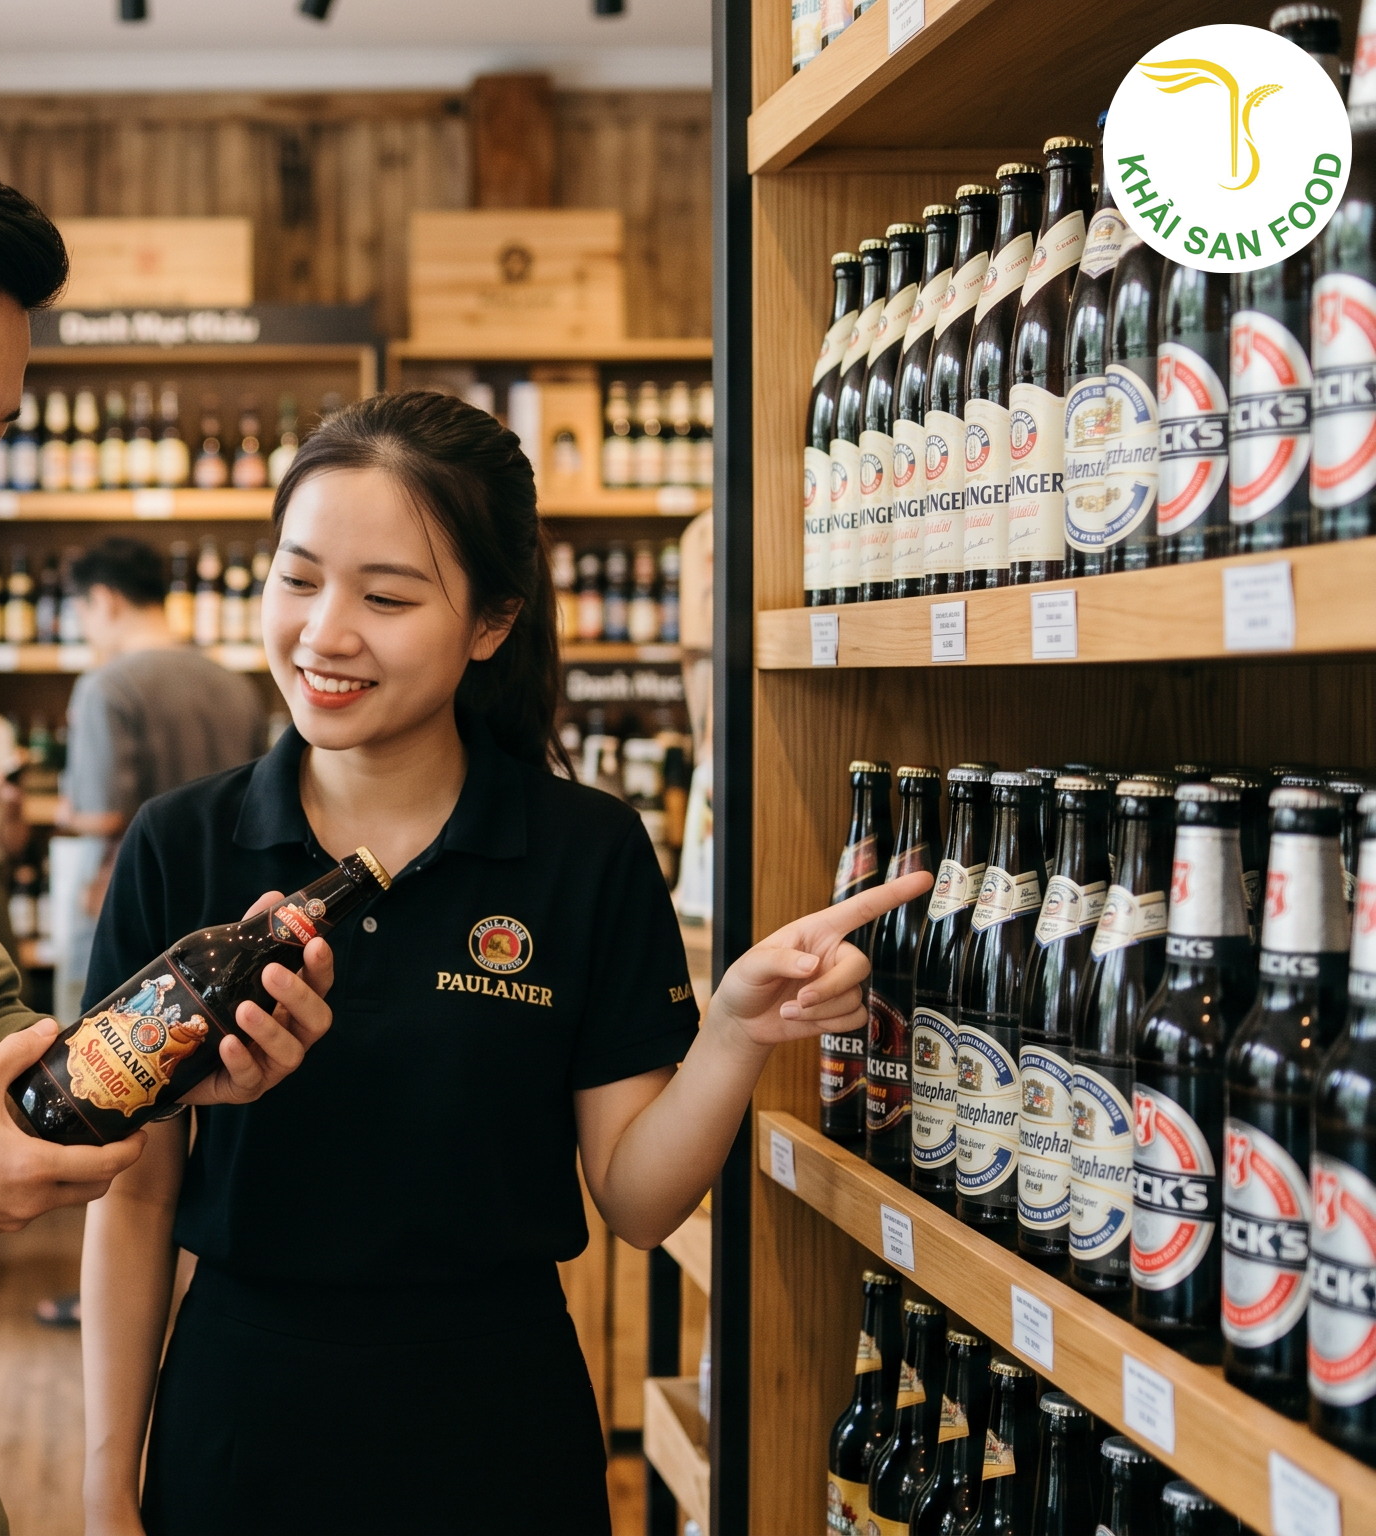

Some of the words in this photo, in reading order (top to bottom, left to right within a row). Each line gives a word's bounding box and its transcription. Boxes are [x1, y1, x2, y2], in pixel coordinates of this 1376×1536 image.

[436, 971, 553, 1007] PAULANER
[80, 1039, 131, 1099] Salvator
[95, 1016, 157, 1093] PAULANER
